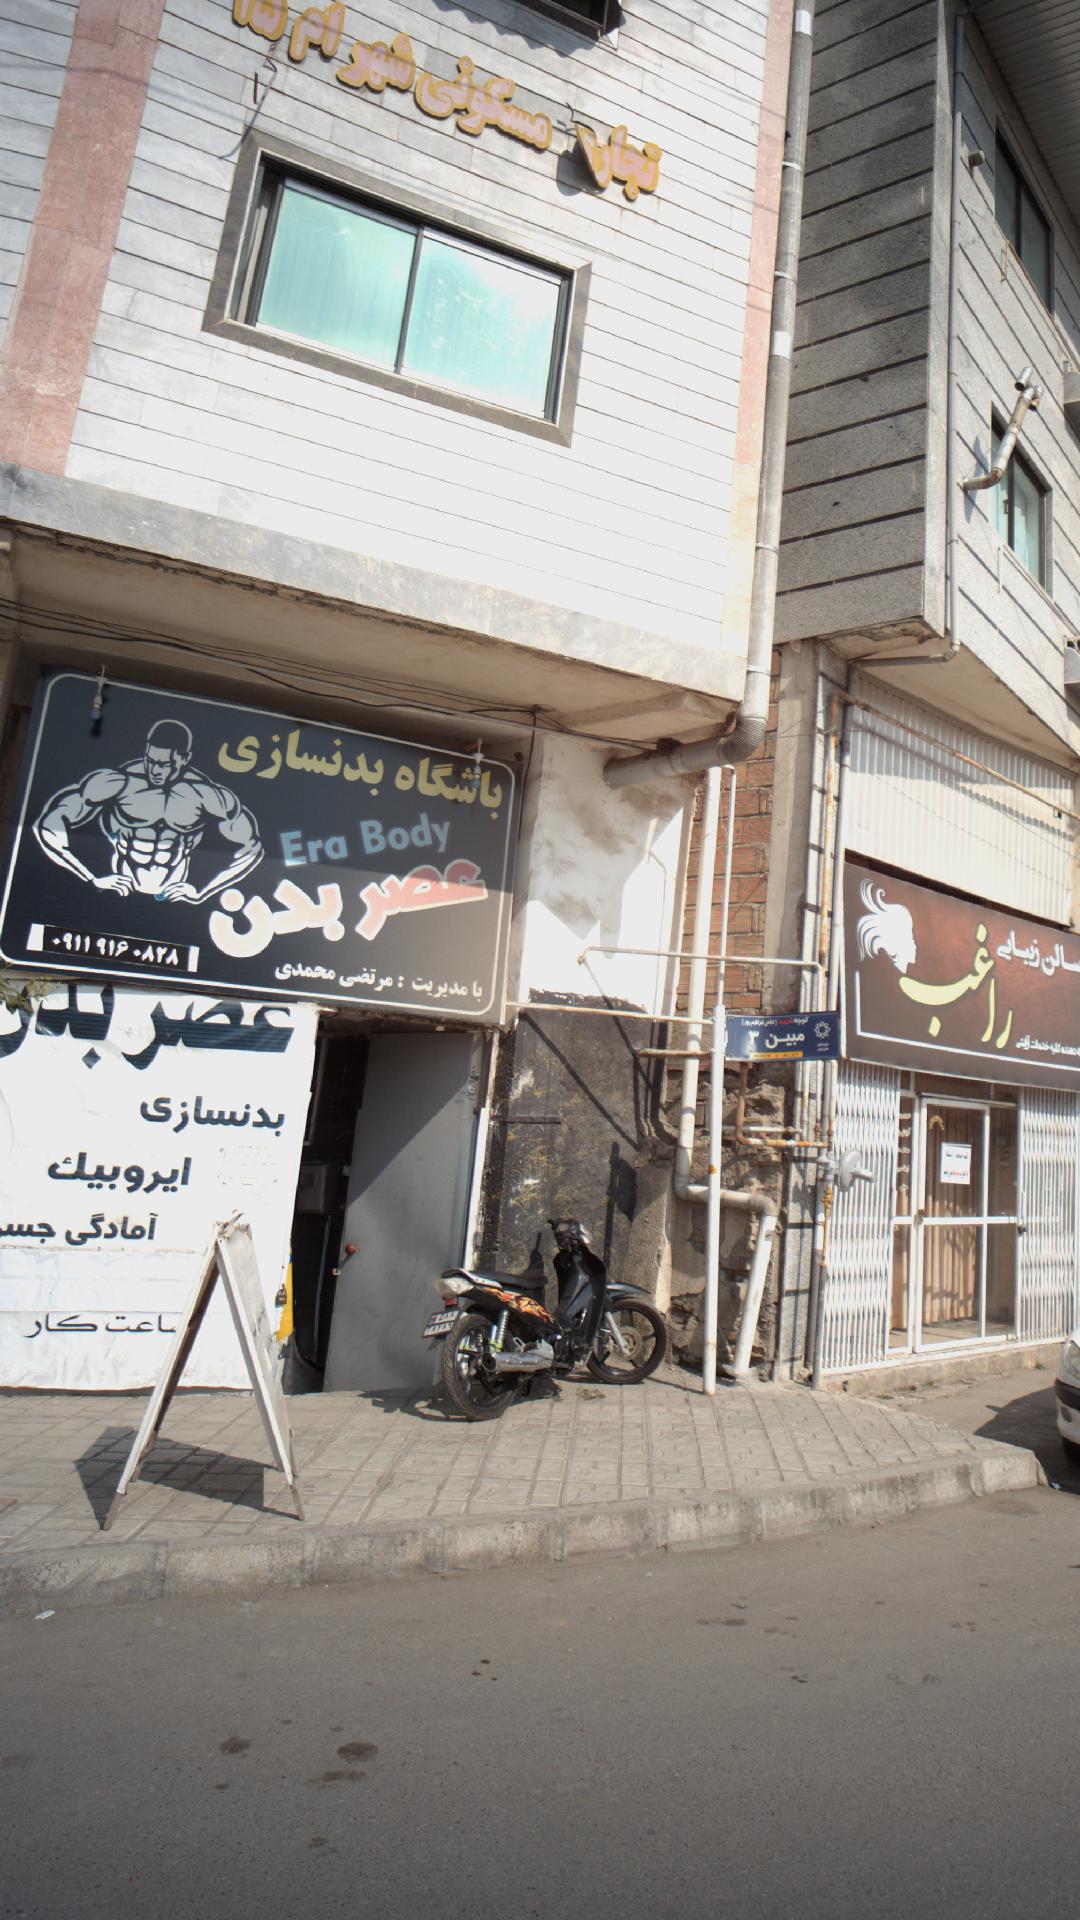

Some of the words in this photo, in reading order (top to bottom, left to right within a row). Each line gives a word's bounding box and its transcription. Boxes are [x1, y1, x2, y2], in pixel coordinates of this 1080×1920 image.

[415, 56, 553, 151] مسکونی
[217, 729, 384, 797] بدنسازی
[394, 757, 504, 820] باشگاه
[280, 831, 348, 868] Era
[361, 812, 452, 856] Body
[355, 858, 489, 942] عصر
[208, 878, 345, 958] بدن
[52, 932, 90, 953] ۰۹۱۱
[96, 937, 129, 957] ۹۱۶
[1041, 943, 1080, 977] الن
[274, 961, 336, 981] محمدی
[338, 967, 394, 991] مرتضی
[411, 977, 468, 998] مدیریت
[898, 921, 1013, 1049] راغب
[472, 981, 484, 1002] با
[120, 998, 295, 1070] عصر
[765, 1031, 806, 1049] مبین
[139, 1095, 286, 1137] بدنسازی
[0, 1222, 56, 1244] جس
[65, 1212, 159, 1246] آمادگی
[23, 1311, 98, 1338] کار
